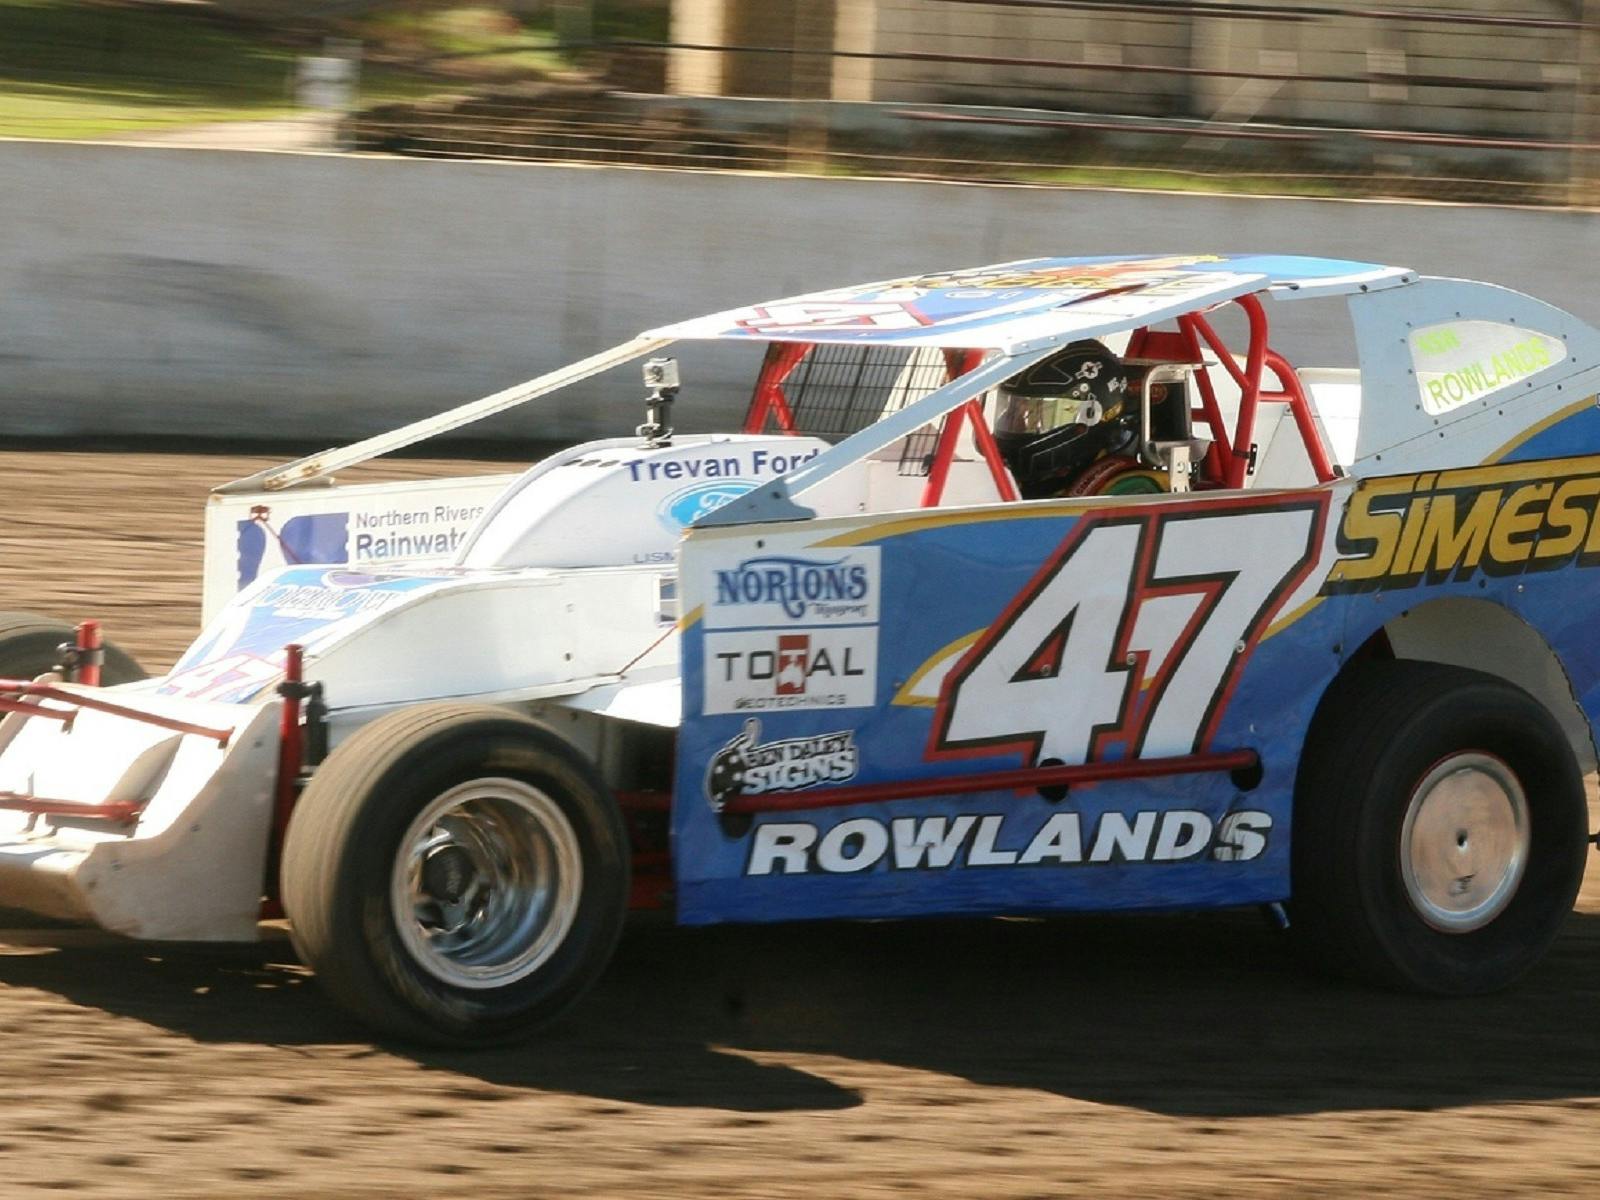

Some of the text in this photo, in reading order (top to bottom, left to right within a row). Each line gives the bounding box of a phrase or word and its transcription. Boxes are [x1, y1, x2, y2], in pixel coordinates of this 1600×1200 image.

[1427, 336, 1550, 409] ROWLANDS
[623, 456, 741, 481] Trevan
[356, 510, 430, 528] Northern
[1326, 474, 1600, 584] SIMES
[933, 500, 1322, 772] 47
[740, 752, 858, 796] SIGNS
[747, 811, 1273, 875] ROWLANDS
